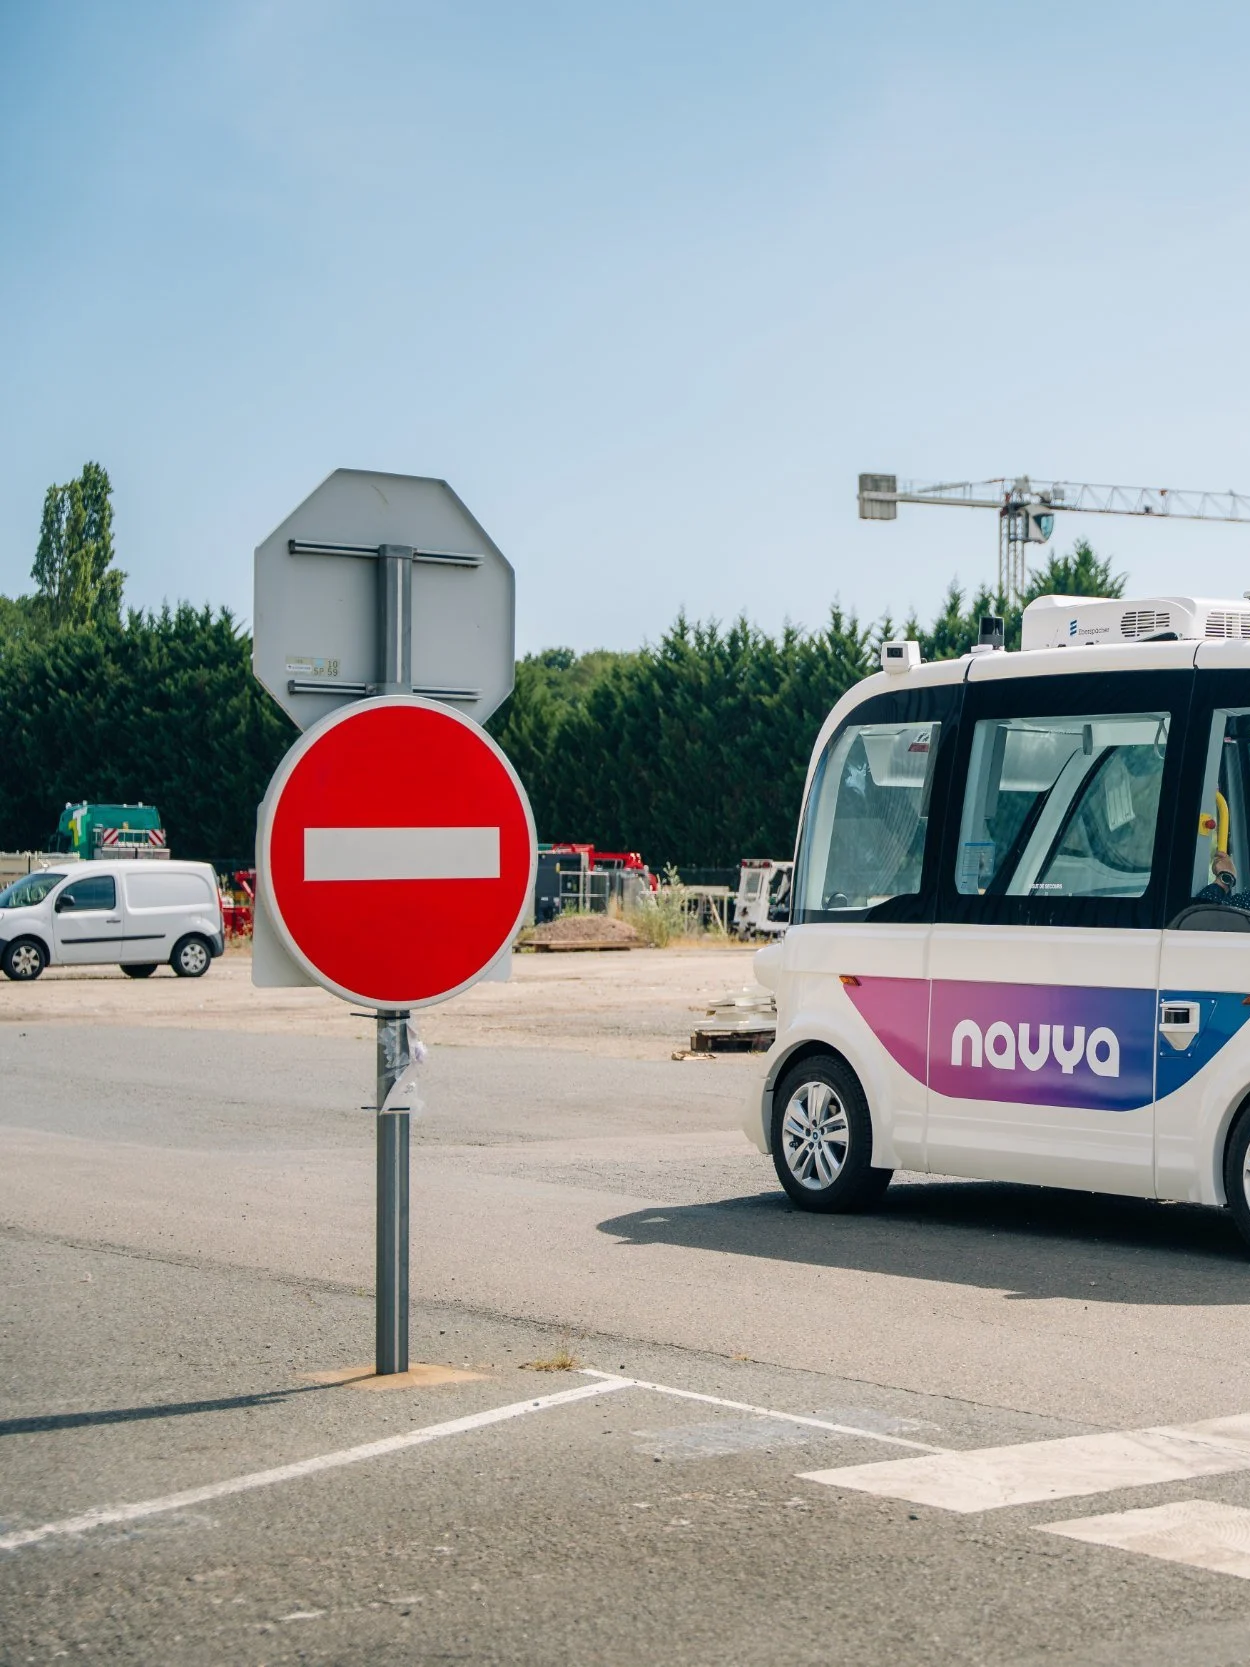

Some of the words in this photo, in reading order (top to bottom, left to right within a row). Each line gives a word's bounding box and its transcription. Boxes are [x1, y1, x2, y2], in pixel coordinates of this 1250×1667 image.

[328, 660, 338, 668] 10
[327, 668, 338, 677] 59
[951, 1019, 1120, 1077] navya
